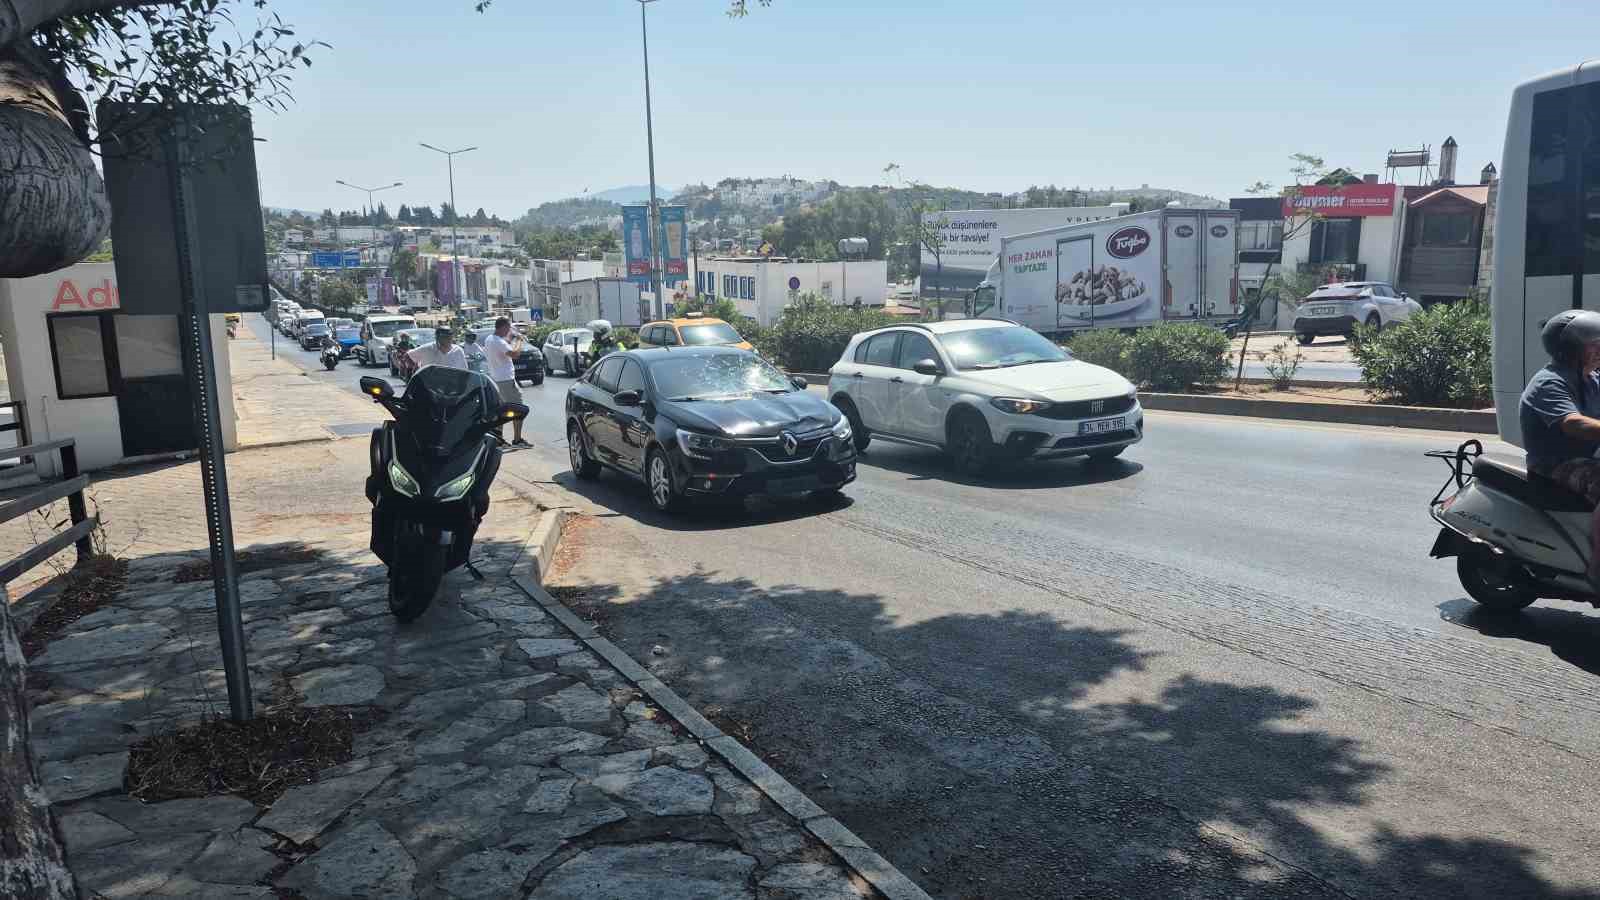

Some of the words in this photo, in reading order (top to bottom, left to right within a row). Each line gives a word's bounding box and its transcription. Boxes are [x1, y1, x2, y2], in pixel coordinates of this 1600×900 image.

[949, 232, 959, 242] bir
[1008, 254, 1023, 265] HER
[1024, 247, 1053, 261] ZAMAN
